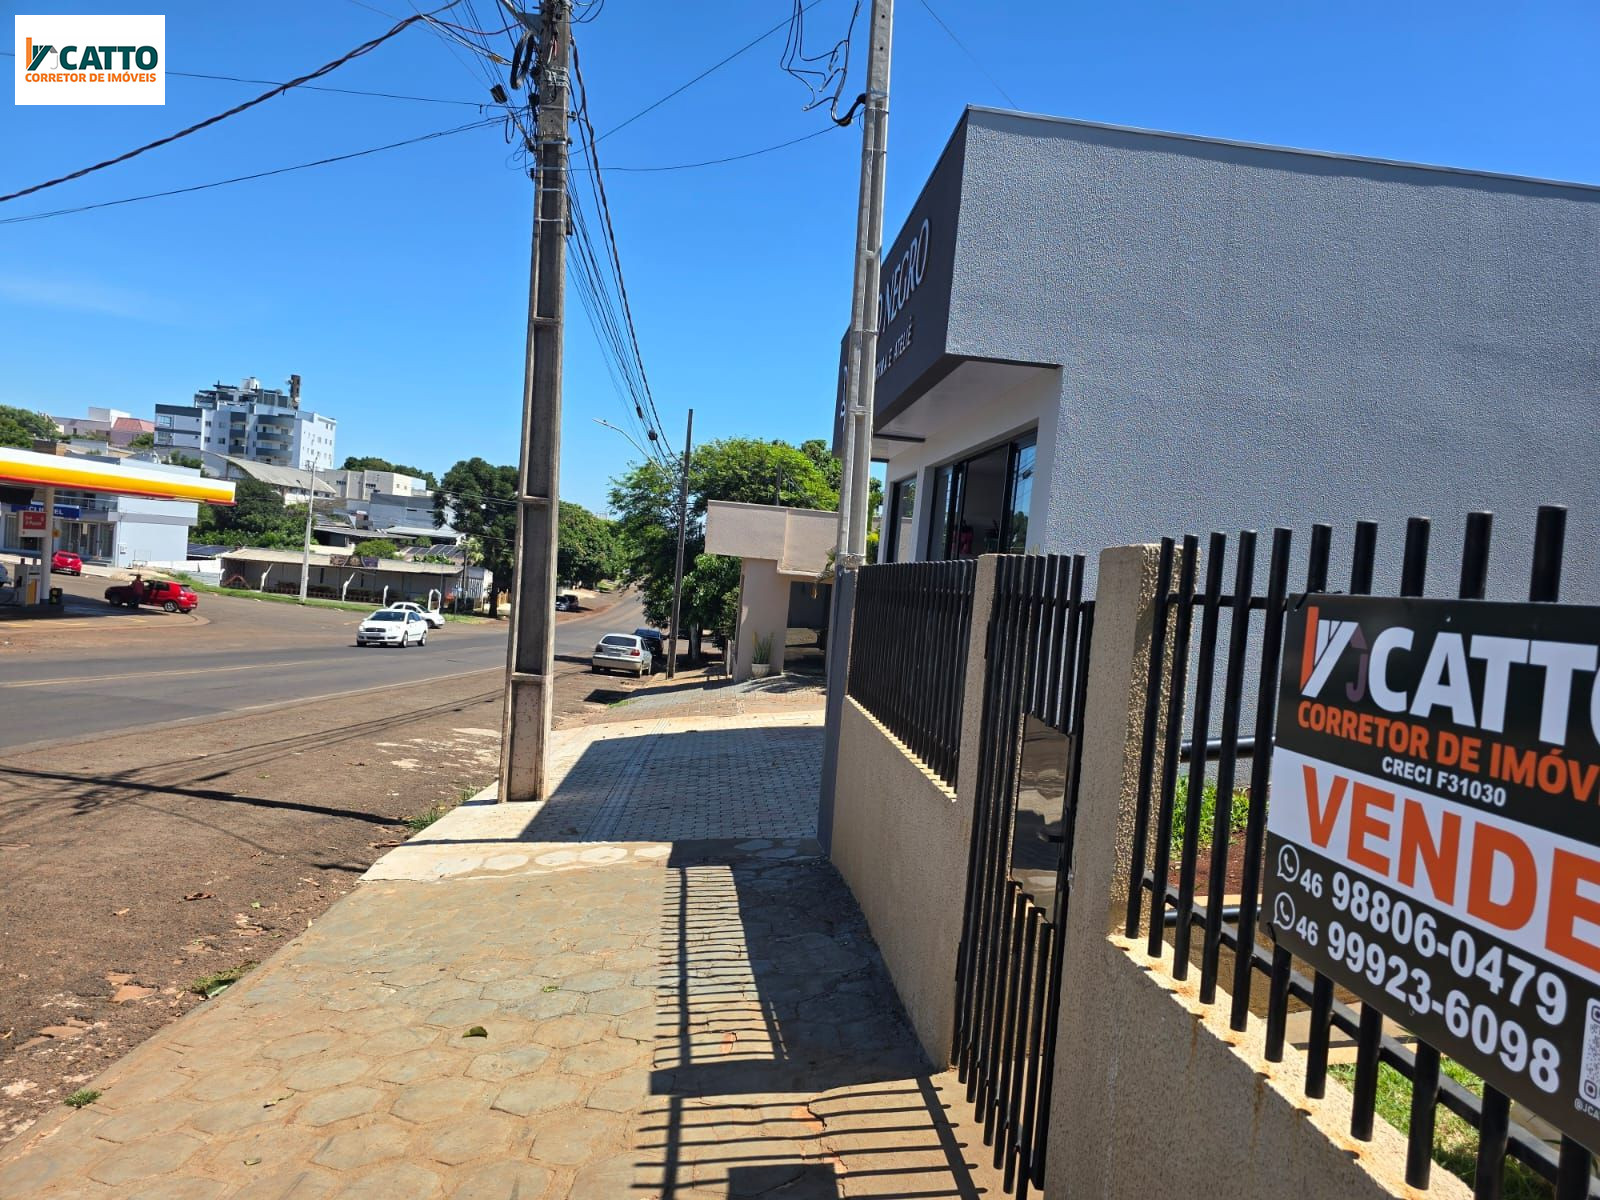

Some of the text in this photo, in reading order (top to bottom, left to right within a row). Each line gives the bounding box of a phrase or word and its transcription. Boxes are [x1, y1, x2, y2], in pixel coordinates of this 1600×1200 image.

[882, 218, 930, 333] NEGRO
[1368, 626, 1600, 746] CATT
[1298, 700, 1600, 805] CORRETOR DE IMÓV
[1382, 756, 1507, 807] CRECI F31030
[1302, 764, 1600, 975] VENDE
[1296, 916, 1561, 1094] 46 99923-6098
[1300, 868, 1568, 1026] 46 98806-0479
